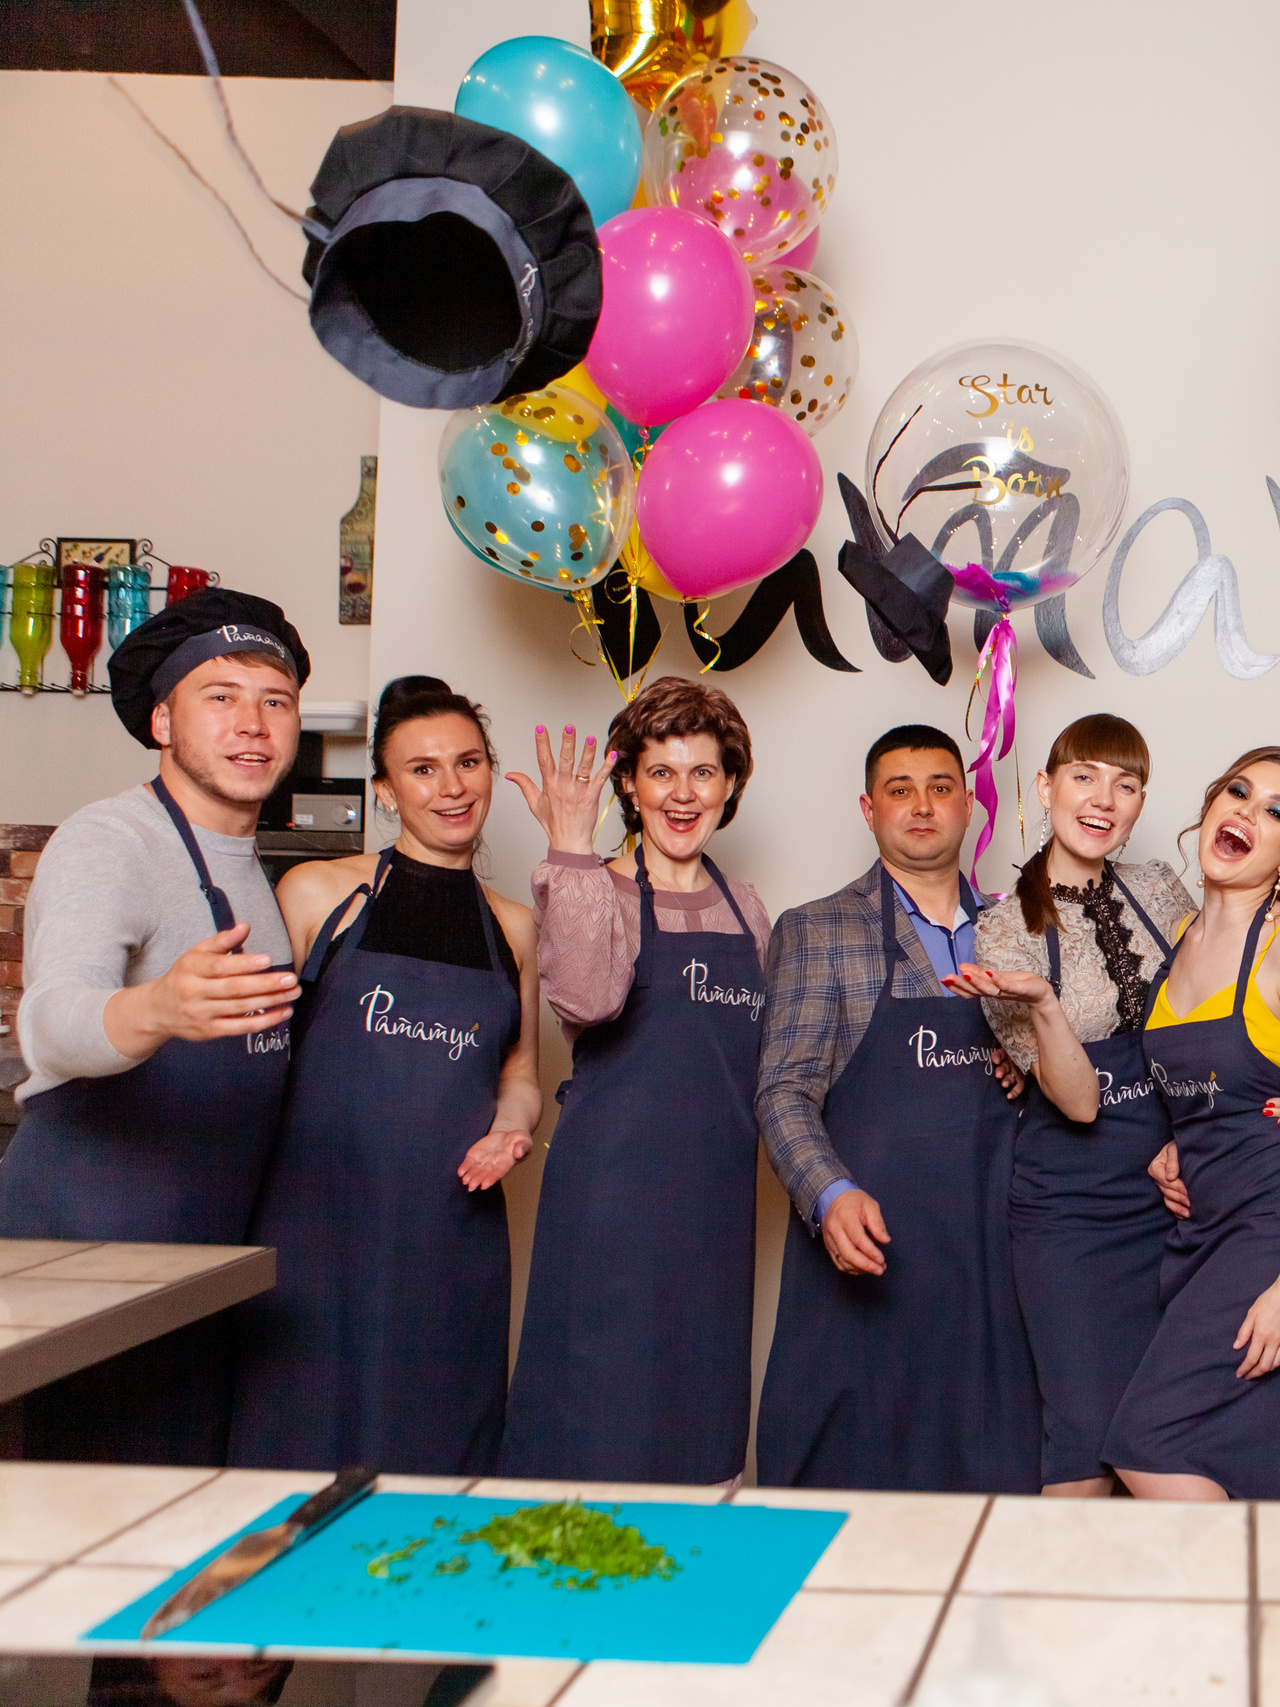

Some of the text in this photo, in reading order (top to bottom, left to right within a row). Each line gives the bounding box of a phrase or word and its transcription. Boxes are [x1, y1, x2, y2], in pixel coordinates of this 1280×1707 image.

[958, 373, 1054, 418] Star
[1006, 422, 1035, 452] is
[960, 455, 1064, 506] Born
[360, 984, 480, 1061] Рататуй
[908, 1025, 997, 1075] Ратату
